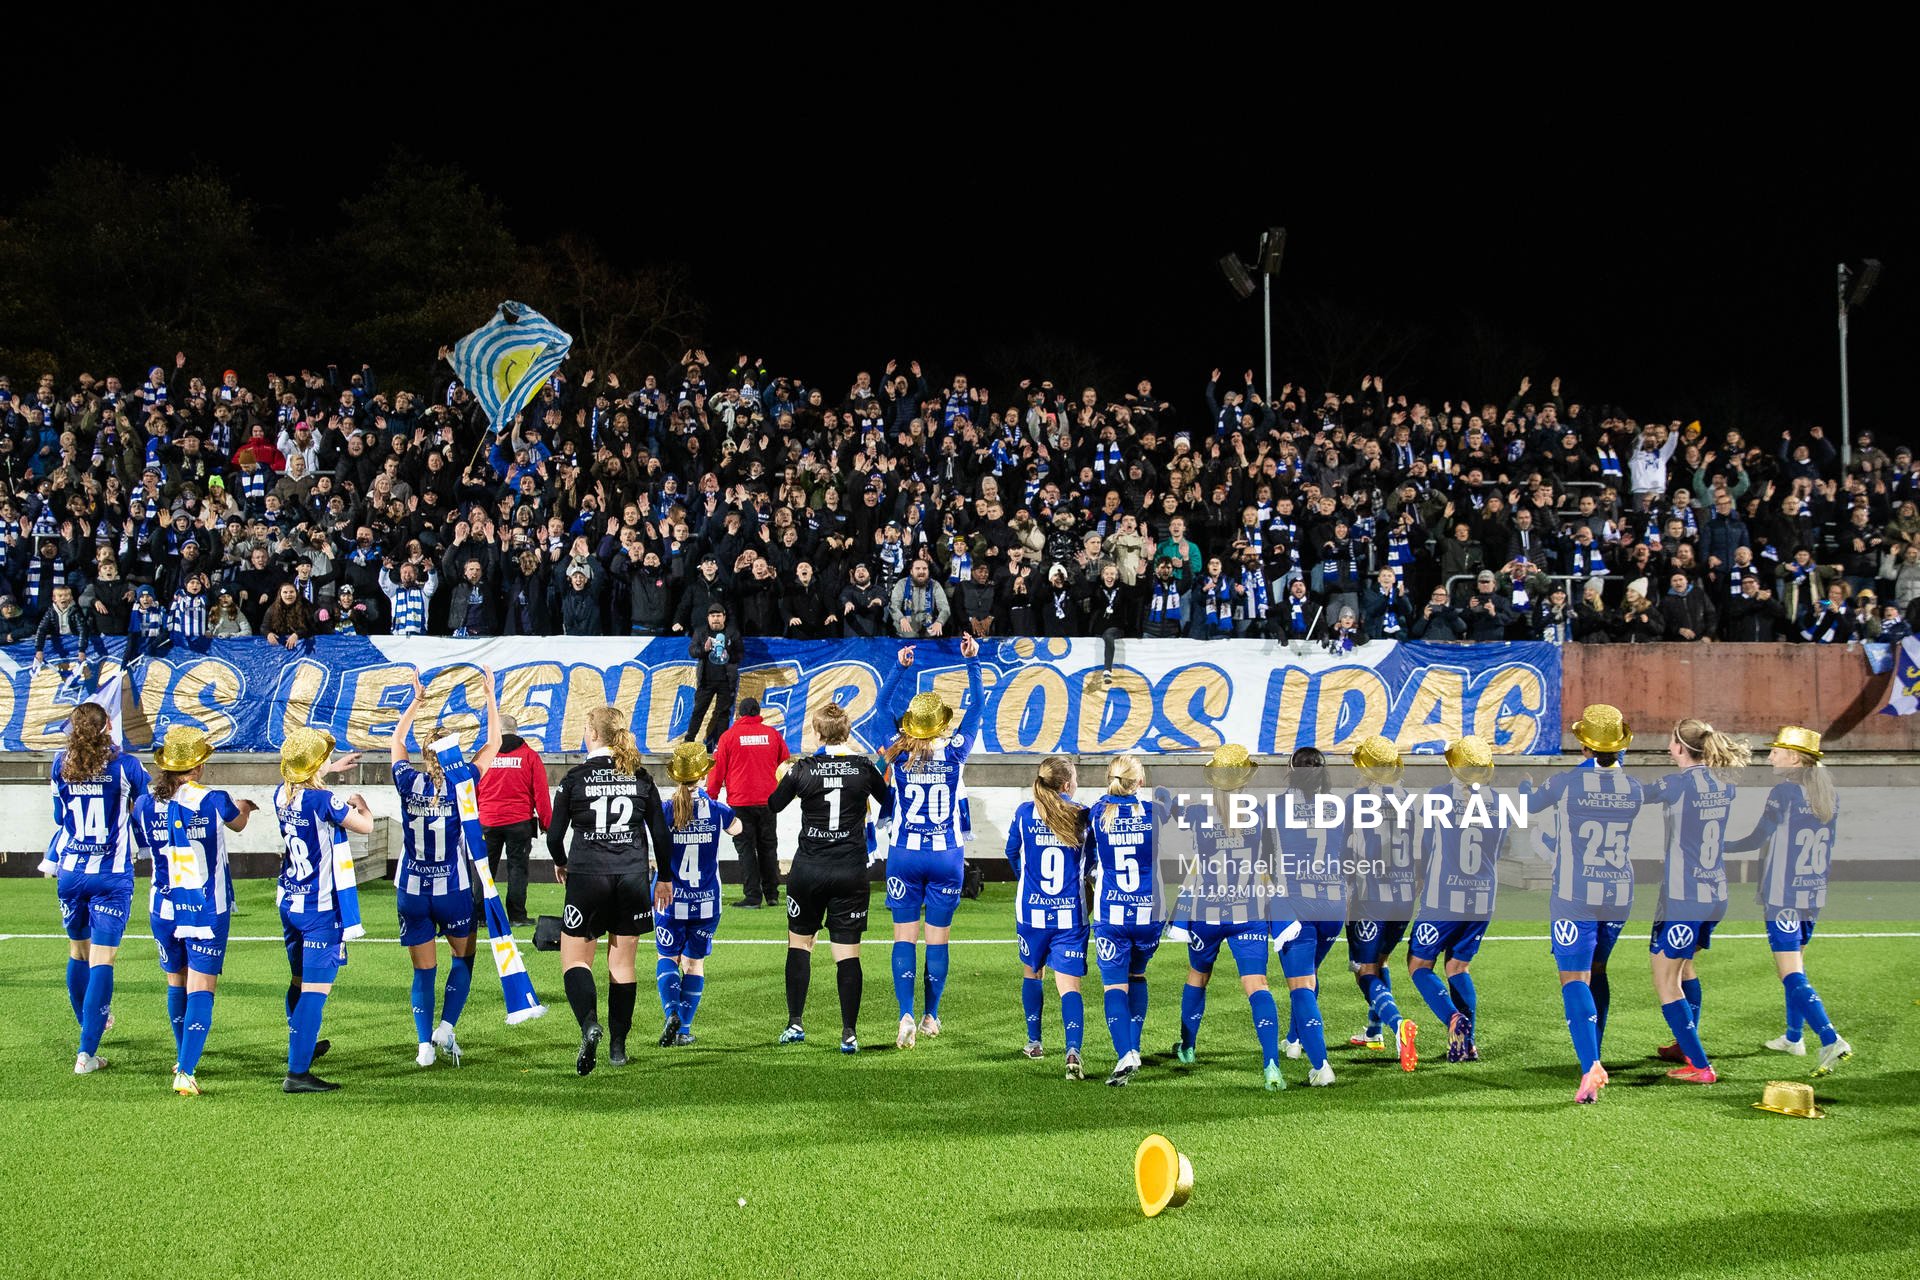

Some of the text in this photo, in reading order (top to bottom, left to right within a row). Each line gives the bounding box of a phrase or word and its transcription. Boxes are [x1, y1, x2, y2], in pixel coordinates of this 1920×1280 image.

[1257, 662, 1547, 755] IDAG
[739, 735, 769, 745] SECURITY
[584, 775, 637, 783] WELLNESS
[585, 784, 637, 797] GUSTAFSSON
[823, 777, 843, 788] DAHL
[906, 774, 946, 784] LUNDBERG
[1587, 792, 1627, 801] NORDIC
[68, 796, 109, 844] 14
[151, 817, 209, 828] WEESS
[589, 795, 634, 833] 12
[824, 788, 841, 831] 1
[904, 783, 951, 824] 20
[1578, 798, 1635, 809] WELLNESS
[409, 816, 446, 862] 11
[673, 833, 713, 845] HOLMBERG
[1108, 832, 1144, 845] MOLUND
[1306, 828, 1327, 870] 7
[1374, 820, 1410, 868] 15
[1459, 827, 1483, 875] 6
[1578, 820, 1629, 870] 25
[1700, 819, 1720, 870] 8
[1795, 828, 1830, 875] 26
[678, 844, 701, 888] 4
[1040, 846, 1065, 895] 9
[1114, 846, 1140, 893] 5
[94, 904, 124, 918] BRIXLY
[192, 943, 222, 957] BRIXLY
[1238, 934, 1268, 942] BRIXLY
